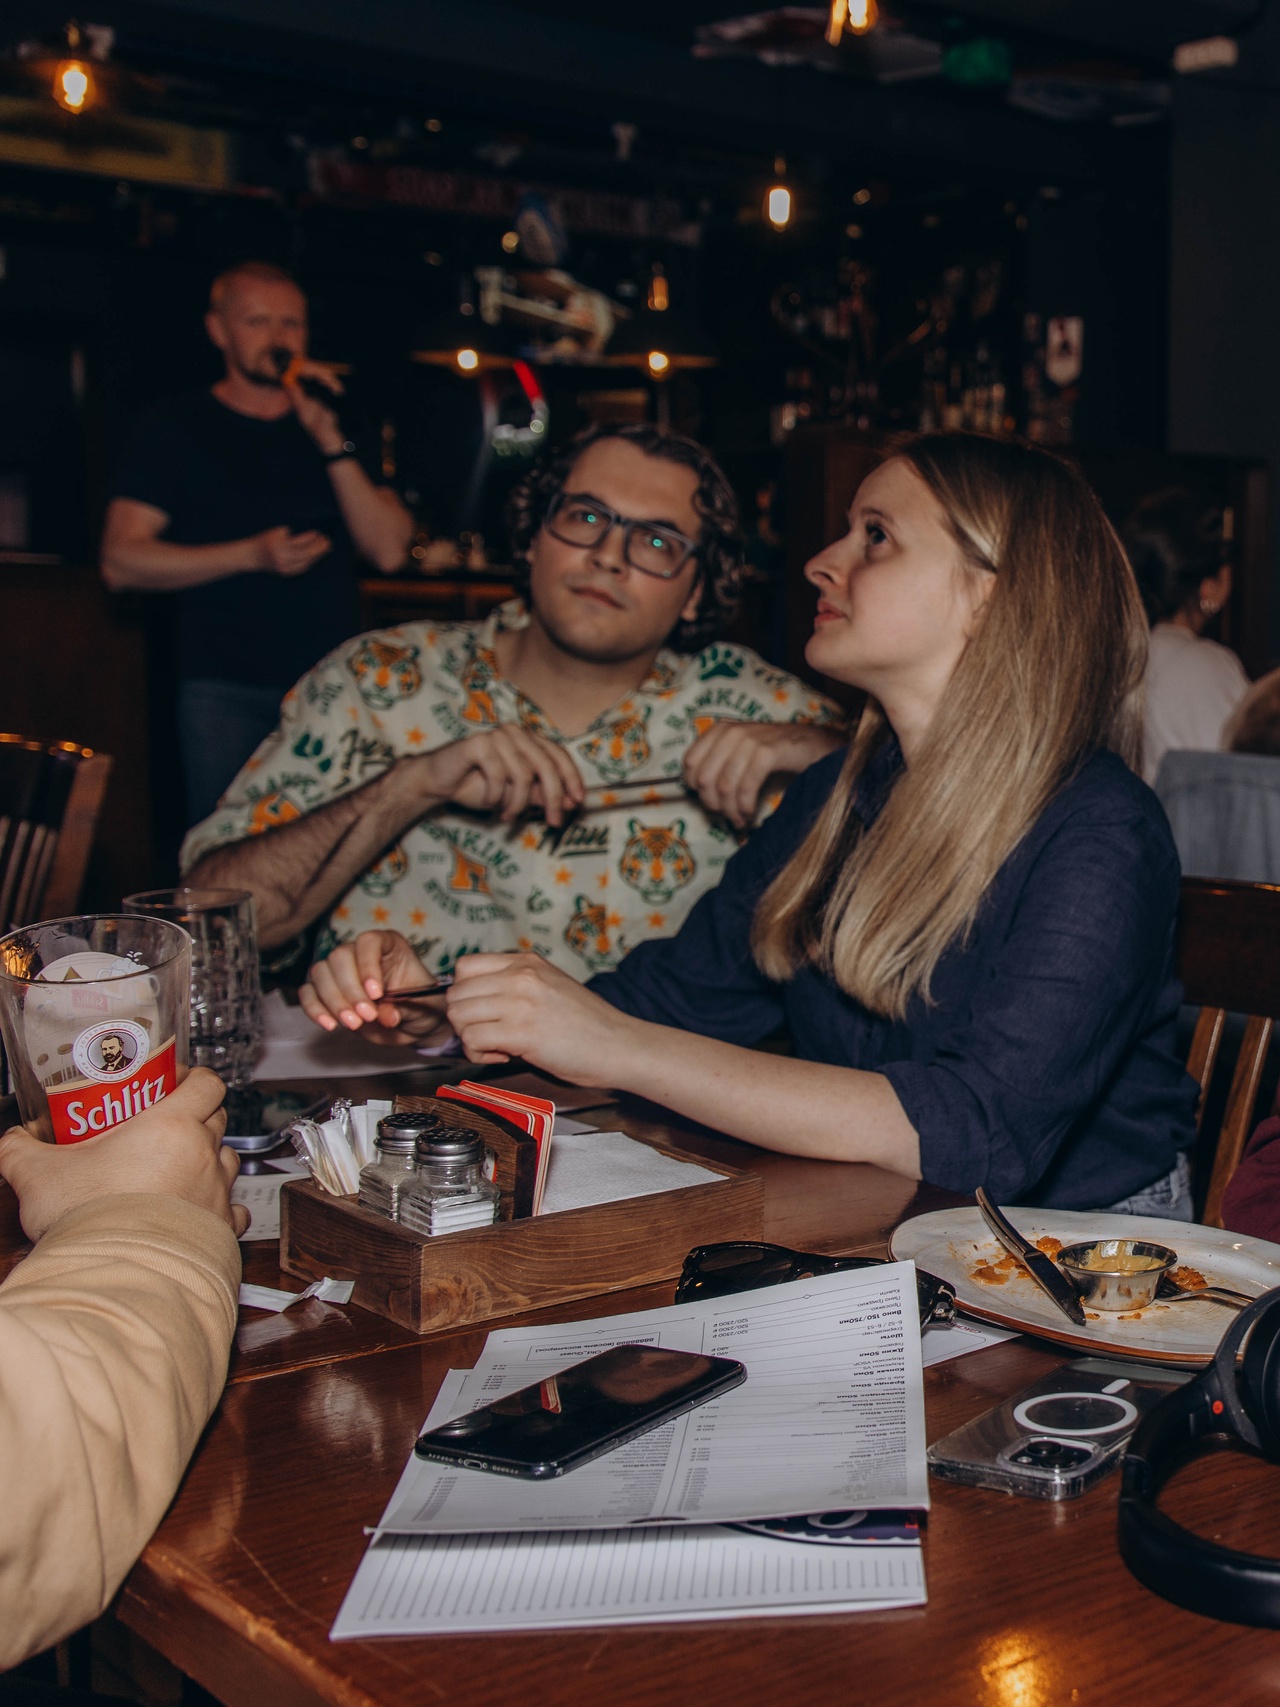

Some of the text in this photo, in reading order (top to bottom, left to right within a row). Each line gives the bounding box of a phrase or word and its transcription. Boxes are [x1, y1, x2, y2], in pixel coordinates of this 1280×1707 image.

[80, 1023, 143, 1048] JOSEPH SCHLITZ
[82, 1061, 115, 1080] BREWING
[67, 1074, 167, 1136] Schlitz
[718, 1318, 748, 1327] 520/2300
[839, 1309, 902, 1325] Вино 150/750мл
[718, 1324, 749, 1332] 520/2300
[718, 1329, 748, 1338] 520/2300
[880, 1332, 904, 1340] Шоты
